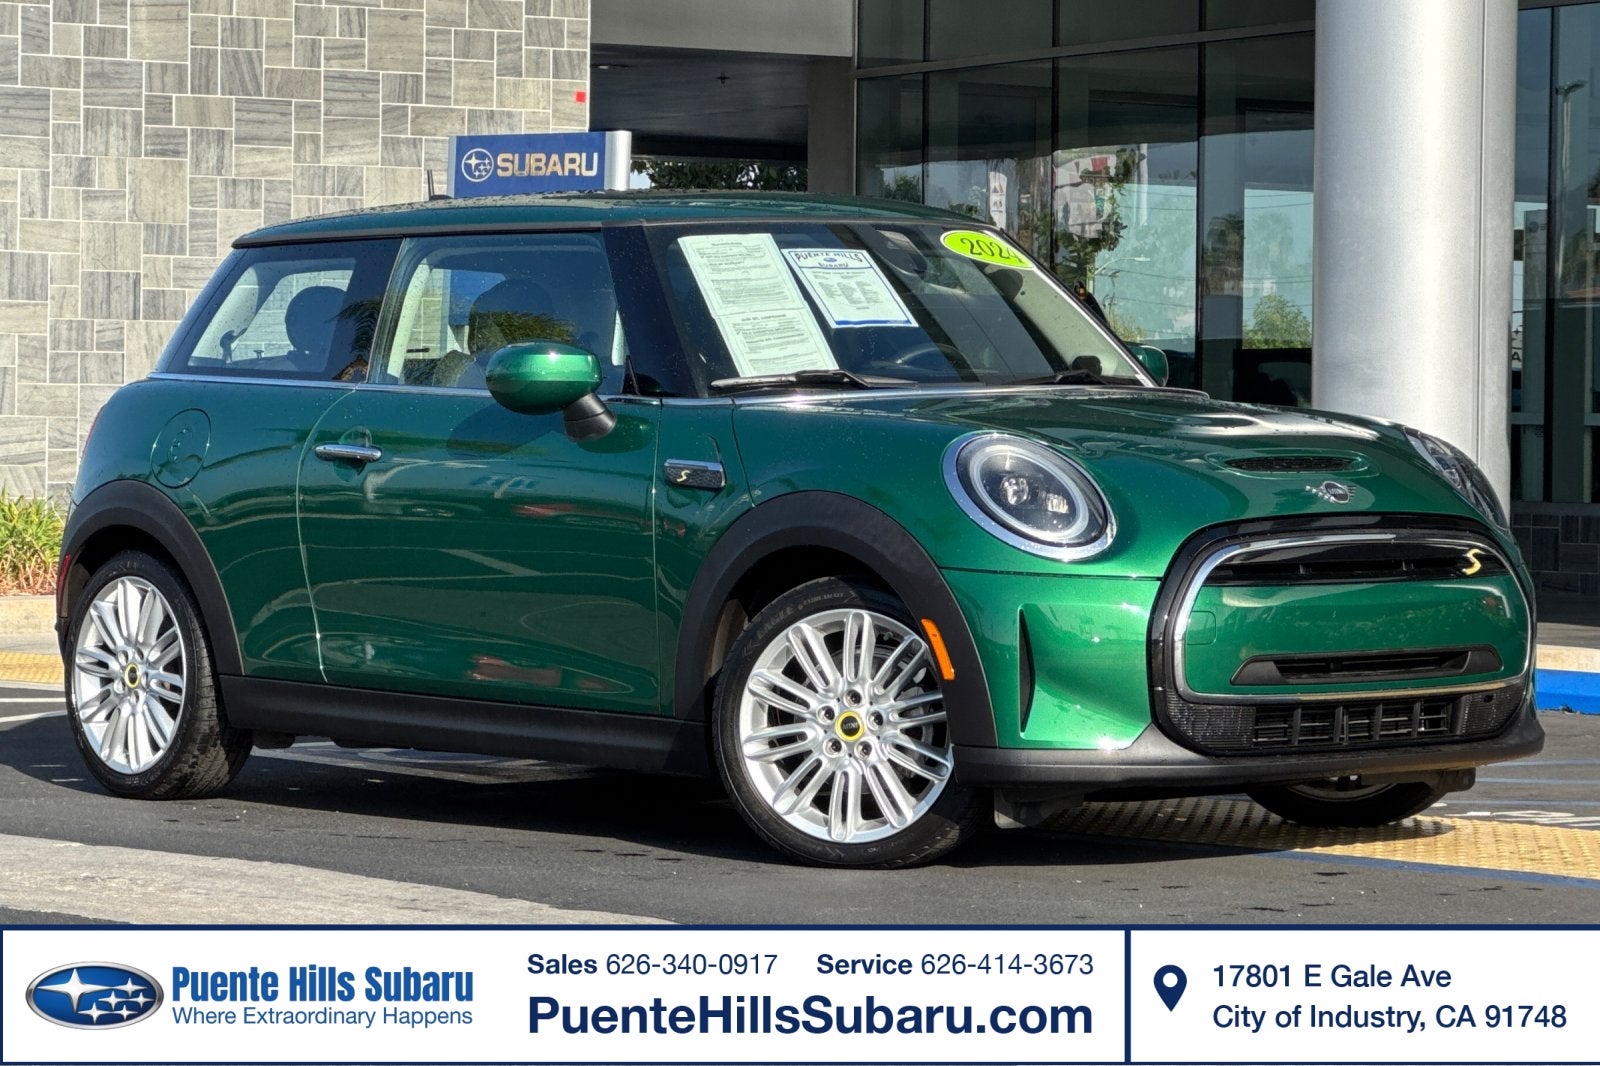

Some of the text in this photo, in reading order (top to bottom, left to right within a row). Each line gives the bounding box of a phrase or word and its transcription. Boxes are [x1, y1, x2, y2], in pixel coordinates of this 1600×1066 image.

[496, 152, 598, 177] SUBARU
[794, 251, 863, 263] PUENTE HILLS
[960, 238, 1025, 264] 2024
[842, 722, 859, 730] MINI
